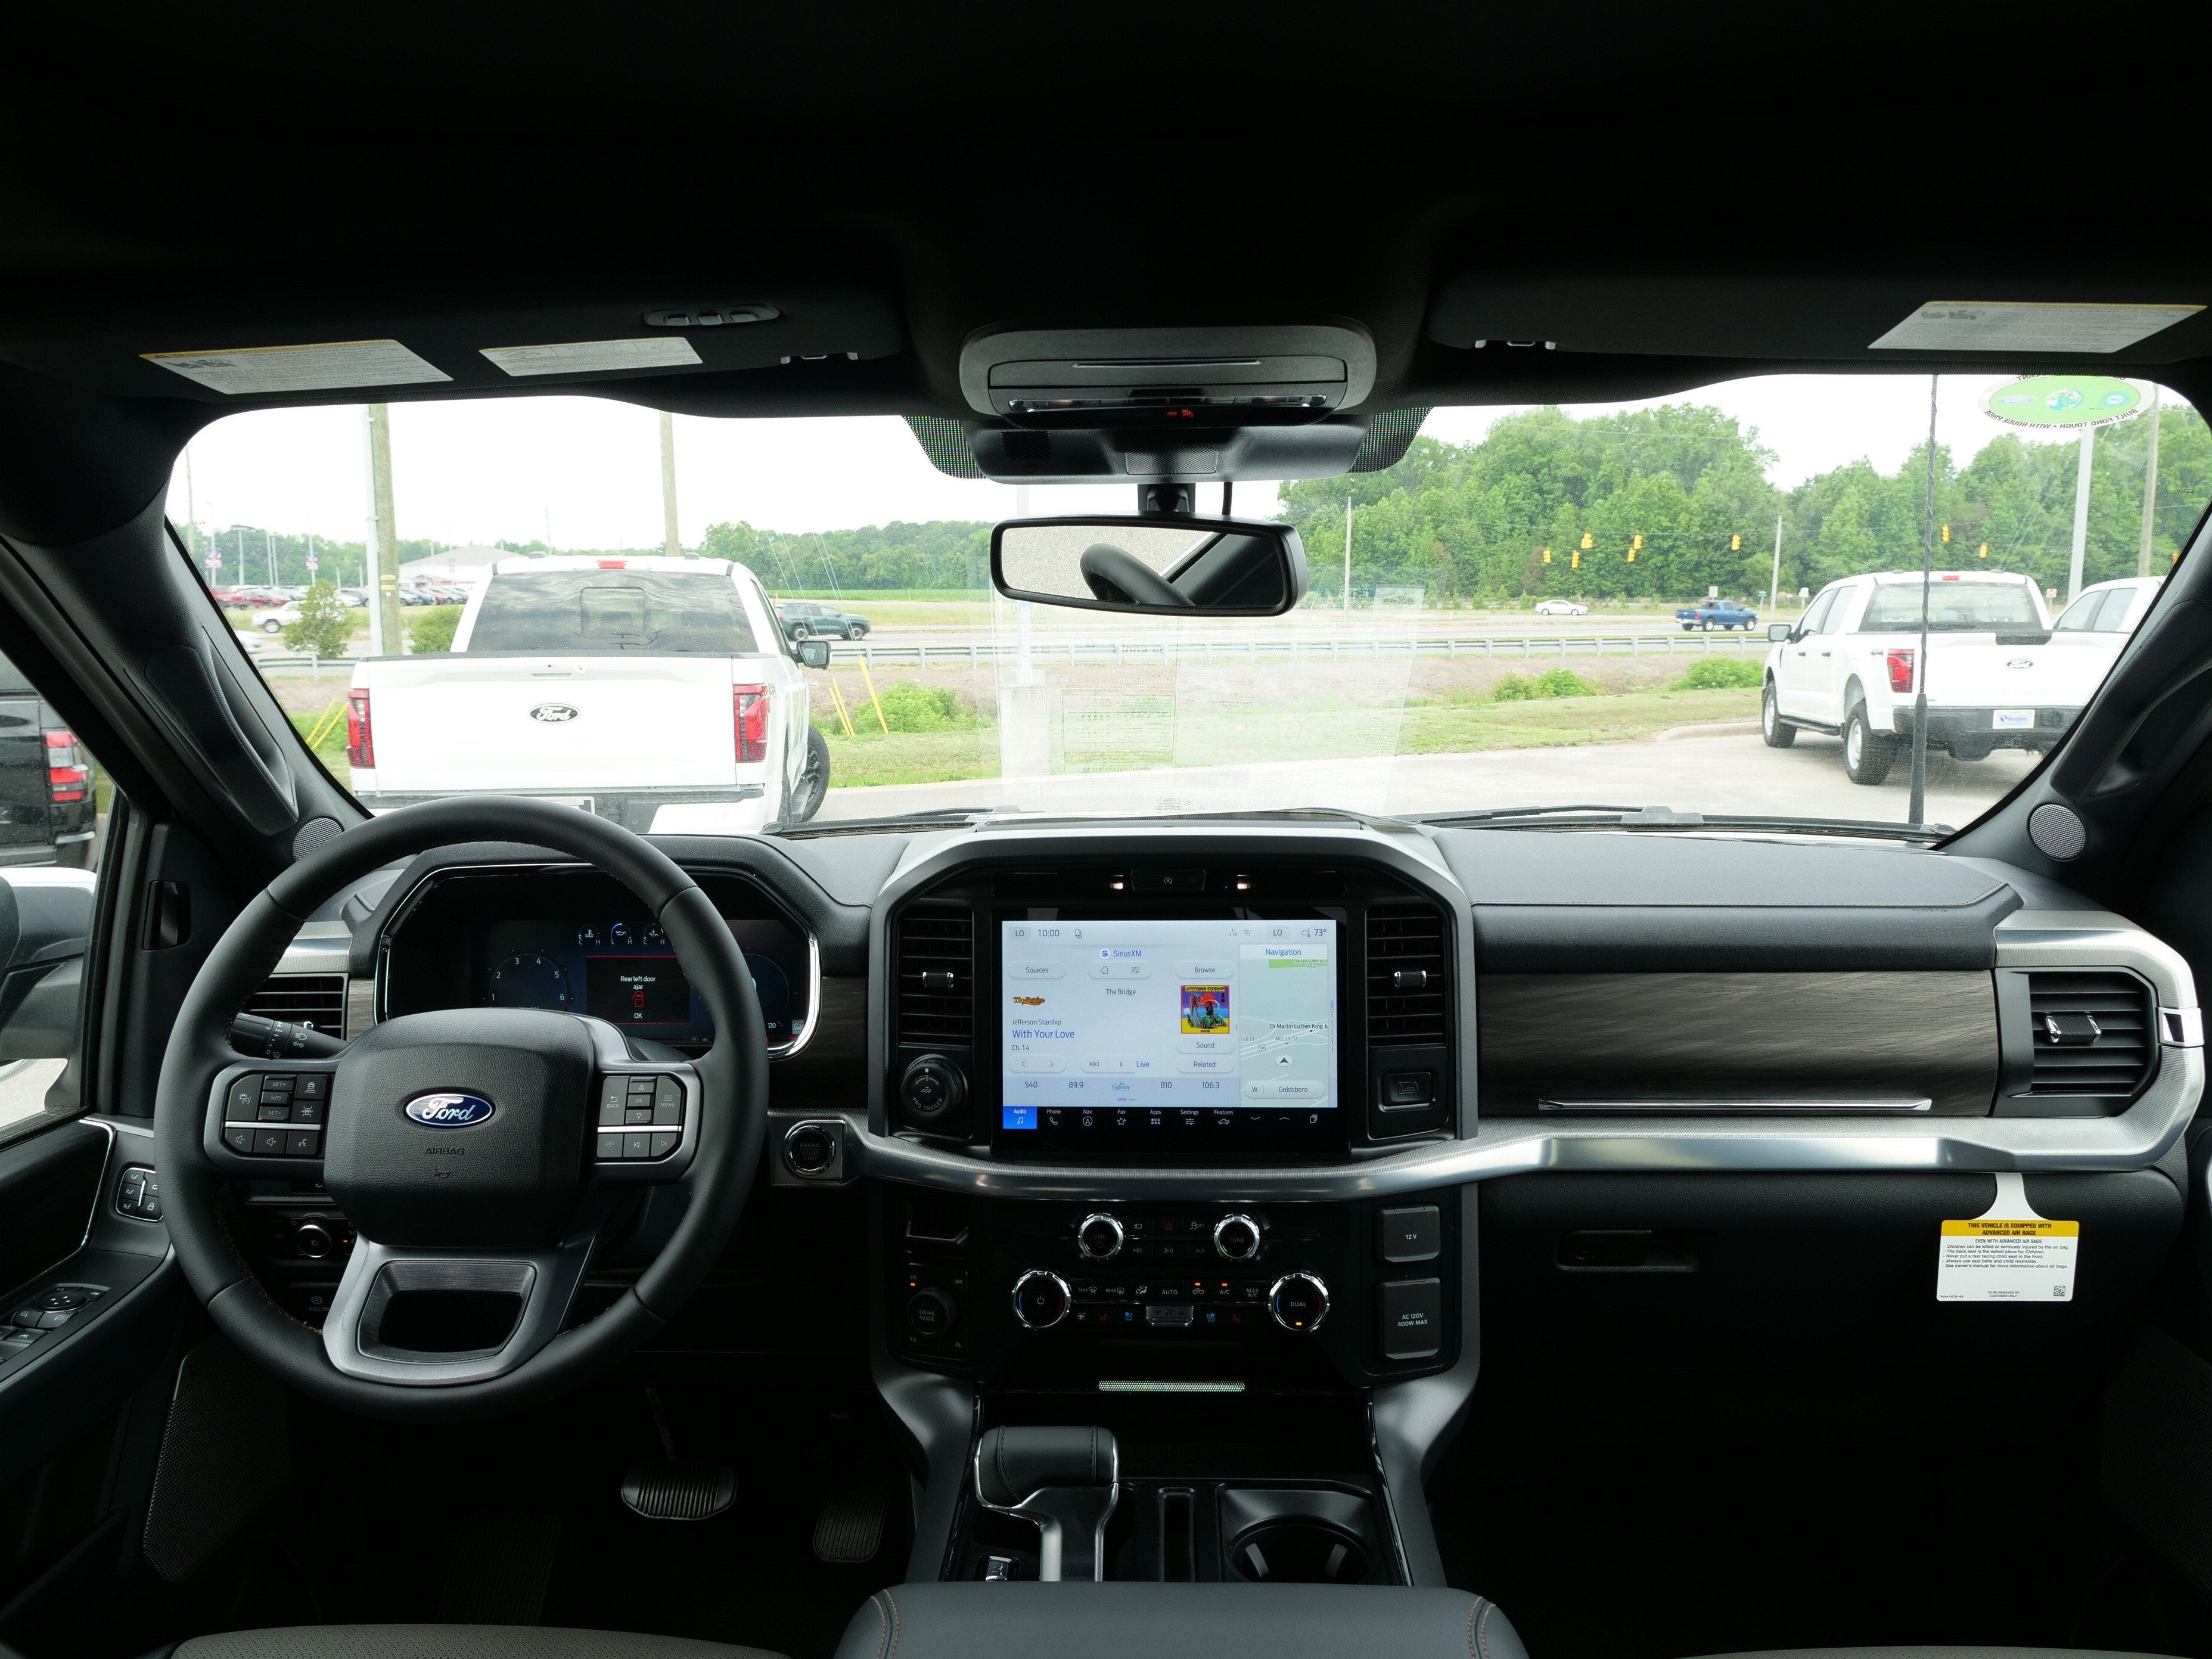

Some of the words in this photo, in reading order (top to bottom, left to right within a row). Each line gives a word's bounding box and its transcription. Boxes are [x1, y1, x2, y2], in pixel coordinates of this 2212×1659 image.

[535, 705, 573, 721] Ford
[1265, 949, 1301, 957] Navigation
[1012, 1029, 1032, 1038] With
[1034, 1029, 1054, 1038] Your
[1055, 1030, 1075, 1038] Love
[421, 1096, 477, 1121] Ford
[912, 1097, 922, 1108] PRO
[924, 1098, 943, 1111] TRAILER
